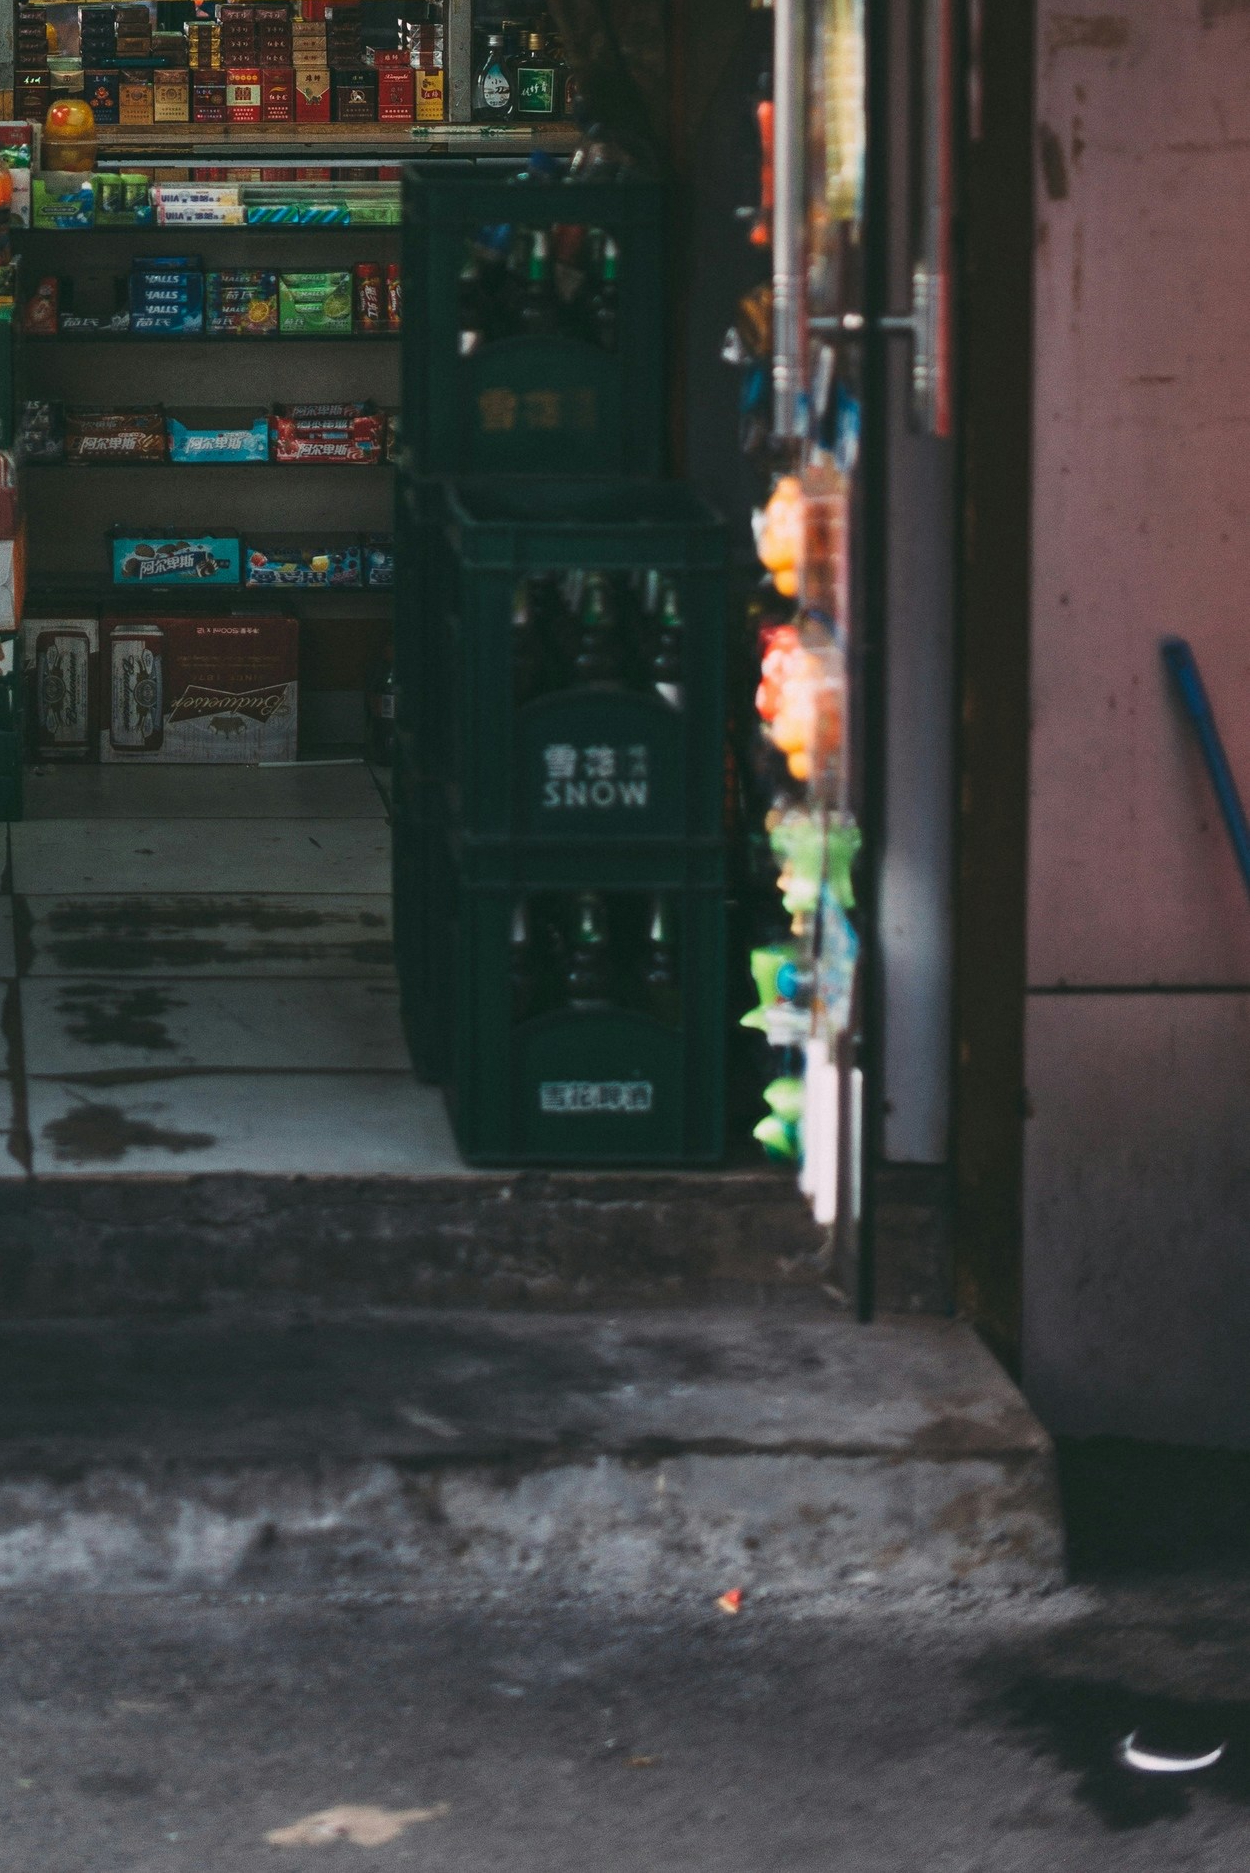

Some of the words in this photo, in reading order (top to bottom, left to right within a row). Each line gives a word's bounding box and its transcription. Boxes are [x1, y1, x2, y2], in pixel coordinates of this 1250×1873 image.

[80, 435, 137, 454] 阿尔卑斯
[187, 433, 243, 453] 阿尔卑斯
[139, 553, 195, 579] 阿尔卑斯
[171, 693, 286, 718] Budweiser
[543, 781, 649, 808] SNOW
